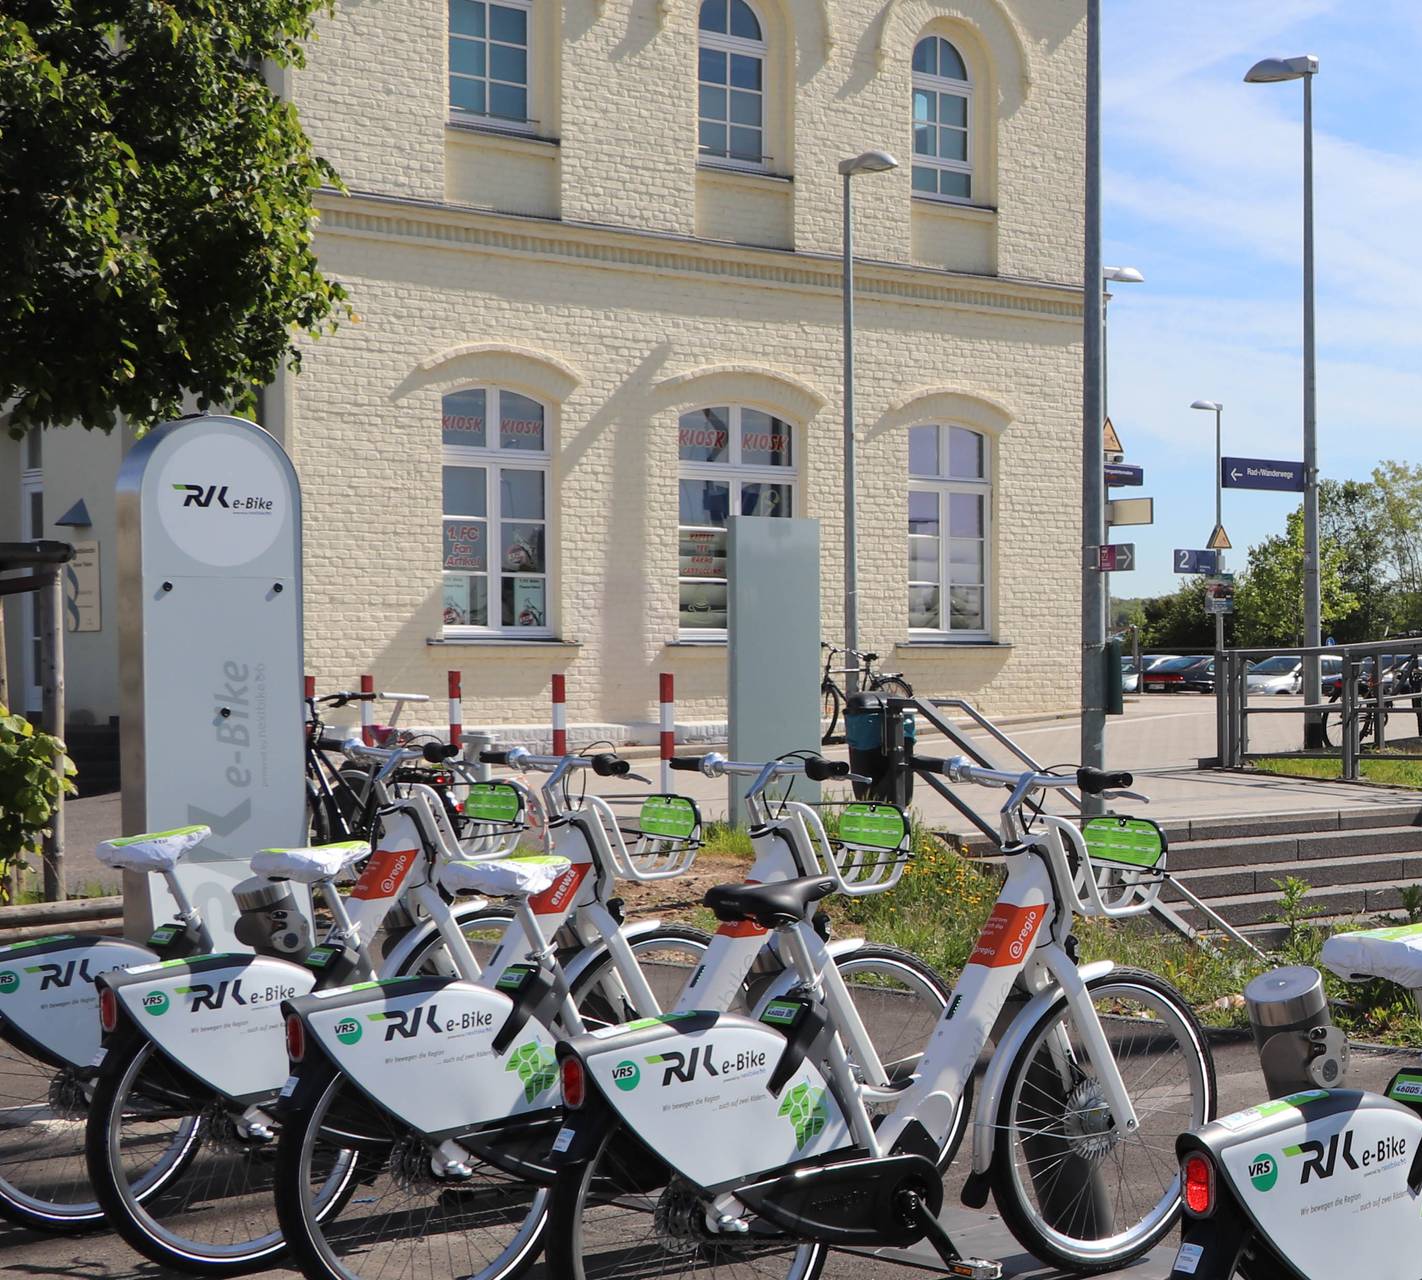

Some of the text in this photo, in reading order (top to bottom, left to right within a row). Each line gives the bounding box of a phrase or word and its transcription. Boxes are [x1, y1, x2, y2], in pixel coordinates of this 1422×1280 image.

[441, 416, 482, 432] KIOSK
[500, 419, 541, 435] KIOSK
[679, 429, 726, 449] KIOSK
[742, 433, 788, 451] KIOSK
[232, 497, 273, 510] e-Bike
[461, 527, 479, 541] FC
[453, 543, 472, 554] Fan
[445, 555, 481, 567] Artikel
[1179, 550, 1189, 568] 2
[142, 995, 163, 1006] VRS
[250, 985, 296, 1004] e-Bike
[334, 1023, 356, 1034] VRS
[446, 1011, 493, 1032] e-Bike
[722, 1050, 766, 1074] e-Bike
[611, 1066, 633, 1079] VRS
[1362, 1135, 1406, 1167] e-Bike
[1249, 1160, 1271, 1177] VRS
[1300, 1192, 1362, 1216] Wir bewegen die Region
[1359, 1200, 1372, 1212] auch
[1372, 1198, 1381, 1209] auf
[1381, 1195, 1392, 1205] zwei
